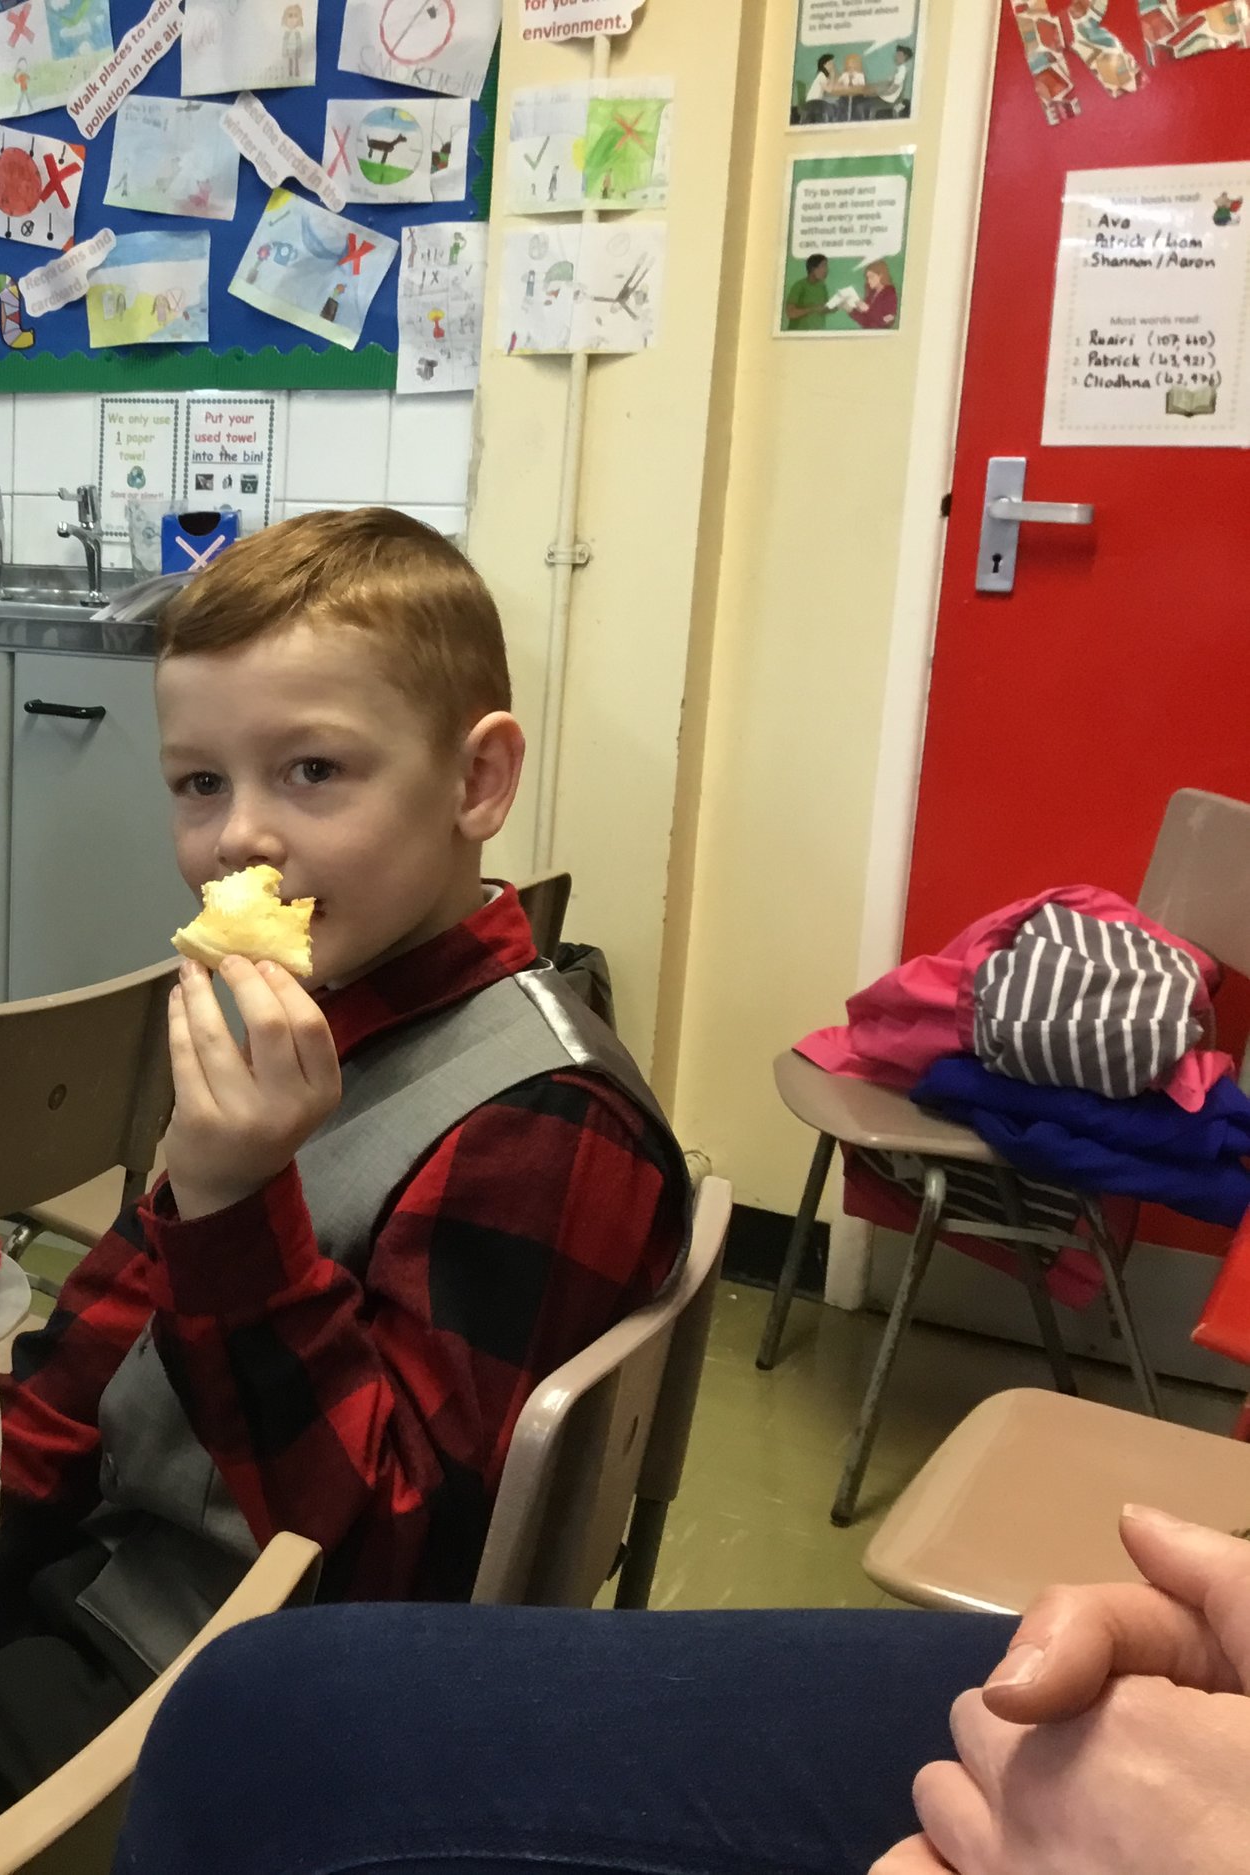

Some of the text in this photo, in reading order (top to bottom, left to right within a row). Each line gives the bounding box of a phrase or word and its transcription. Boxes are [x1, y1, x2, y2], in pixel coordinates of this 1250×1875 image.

[522, 14, 627, 41] environment.
[70, 82, 100, 116] Walk
[99, 43, 132, 86] places
[131, 27, 146, 44] to
[85, 78, 131, 137] pollution
[128, 63, 143, 79] in
[141, 40, 164, 65] the
[820, 188, 831, 196] to
[832, 187, 856, 196] read
[857, 186, 876, 195] and
[827, 213, 853, 223] every
[1097, 213, 1131, 230] Ava
[1094, 232, 1146, 249] Patrick
[1166, 251, 1216, 269] Aaron
[1087, 350, 1140, 368] Patrick
[108, 412, 172, 428] We only use
[204, 411, 255, 427] Put your
[126, 434, 156, 447] paper
[194, 431, 257, 444] used towel
[119, 451, 146, 463] towel
[191, 450, 215, 463] into
[218, 450, 238, 463] the
